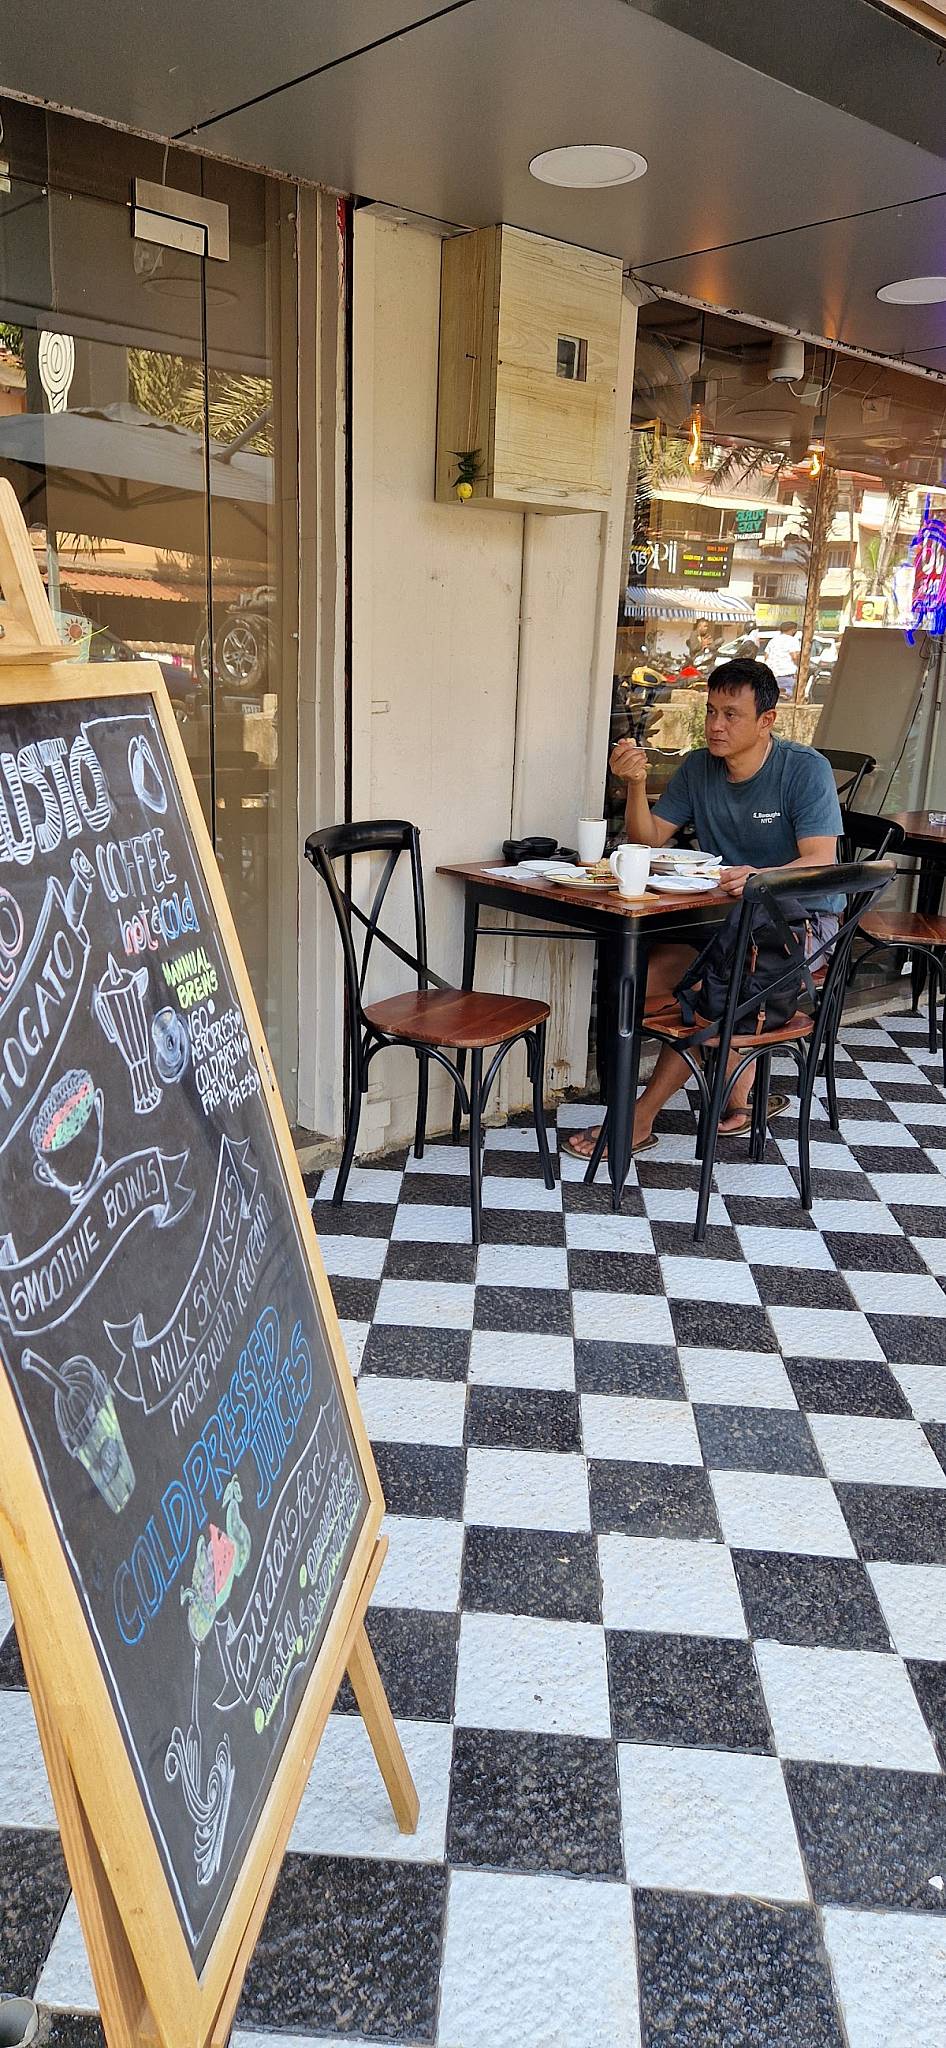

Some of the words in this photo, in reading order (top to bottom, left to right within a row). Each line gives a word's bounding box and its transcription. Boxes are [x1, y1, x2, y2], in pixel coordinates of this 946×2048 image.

[0, 735, 112, 866] USTO
[95, 827, 177, 904] COFFEE
[176, 971, 218, 1009] BREWS
[190, 1011, 240, 1065] AEROPRESS
[201, 1071, 238, 1116] FRENCH
[228, 1074, 259, 1115] PRESS
[10, 1215, 101, 1321] SMOOTHIE
[103, 1158, 161, 1230] BOWLS
[150, 1319, 197, 1393] MILK
[197, 1165, 241, 1327] SHAKES
[170, 1353, 210, 1437] made
[206, 1289, 238, 1373] with
[256, 1320, 314, 1509] JUICES
